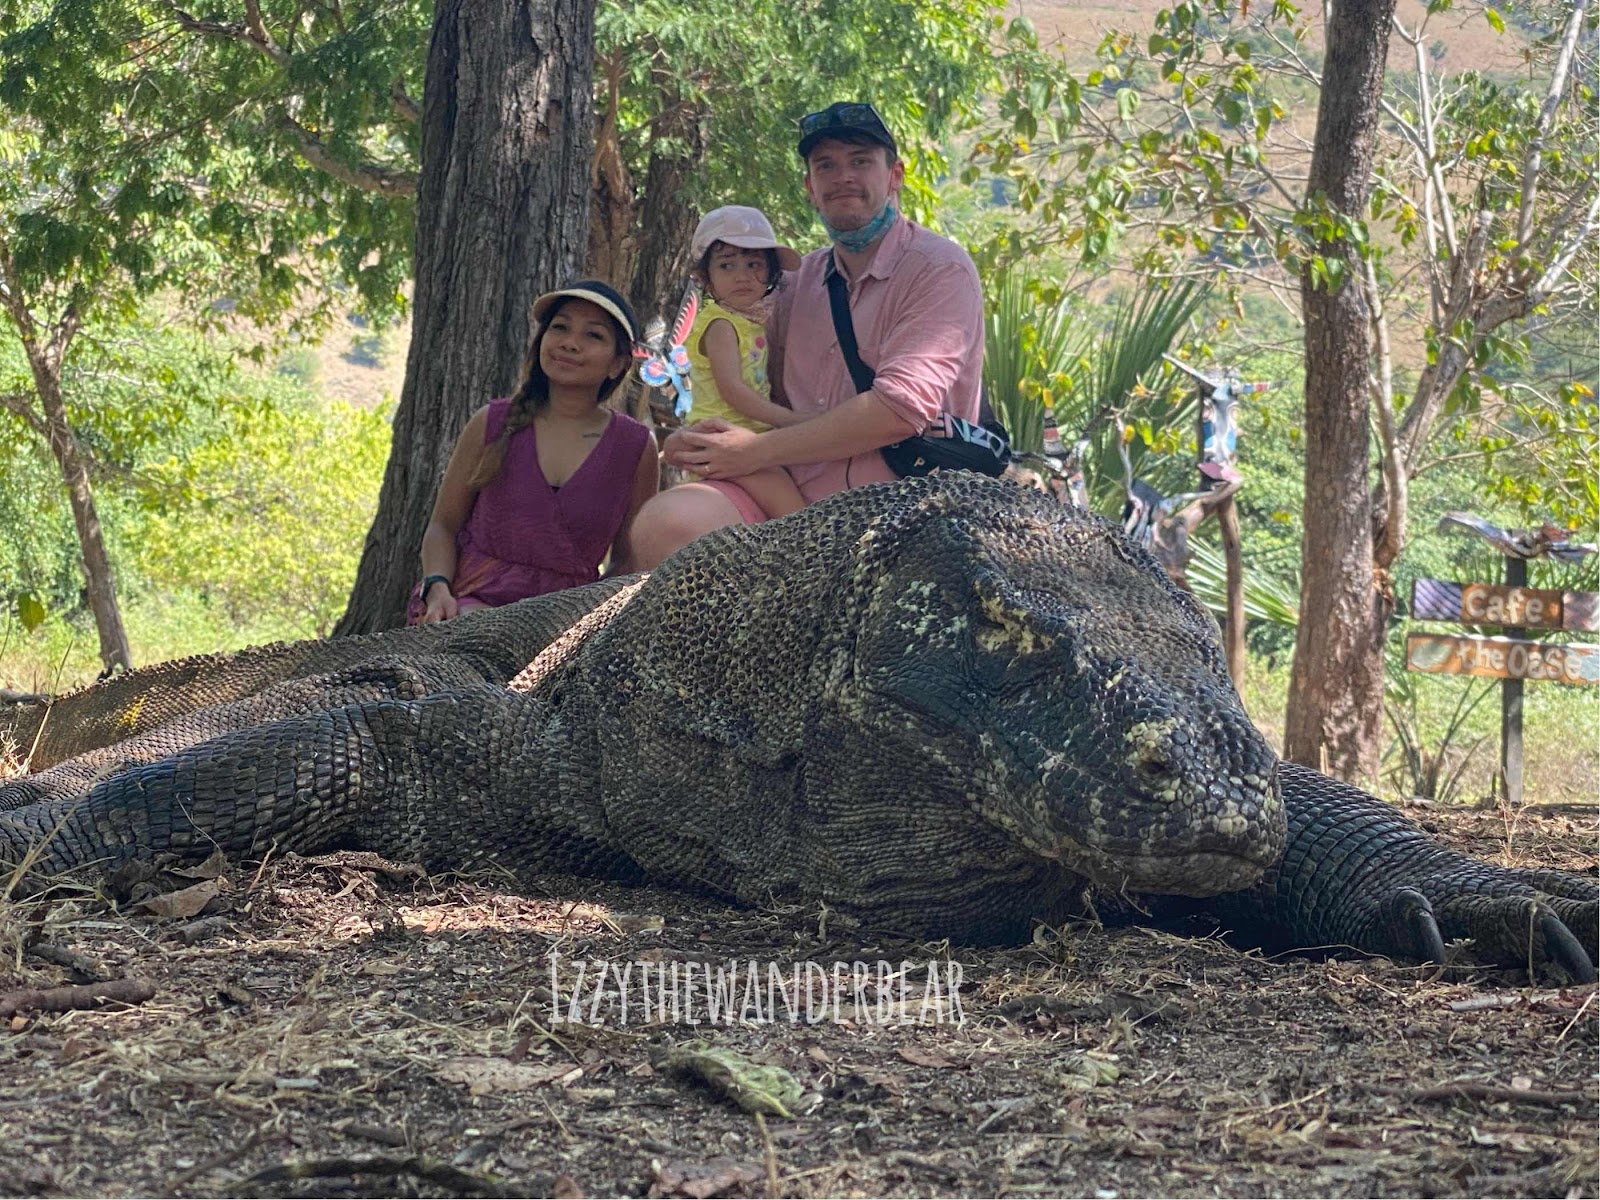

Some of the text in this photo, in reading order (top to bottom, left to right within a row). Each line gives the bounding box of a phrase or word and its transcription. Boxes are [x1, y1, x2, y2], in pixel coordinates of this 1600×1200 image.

[928, 412, 1005, 459] ENZO
[1466, 589, 1543, 624] Cafe
[1457, 640, 1504, 669] the
